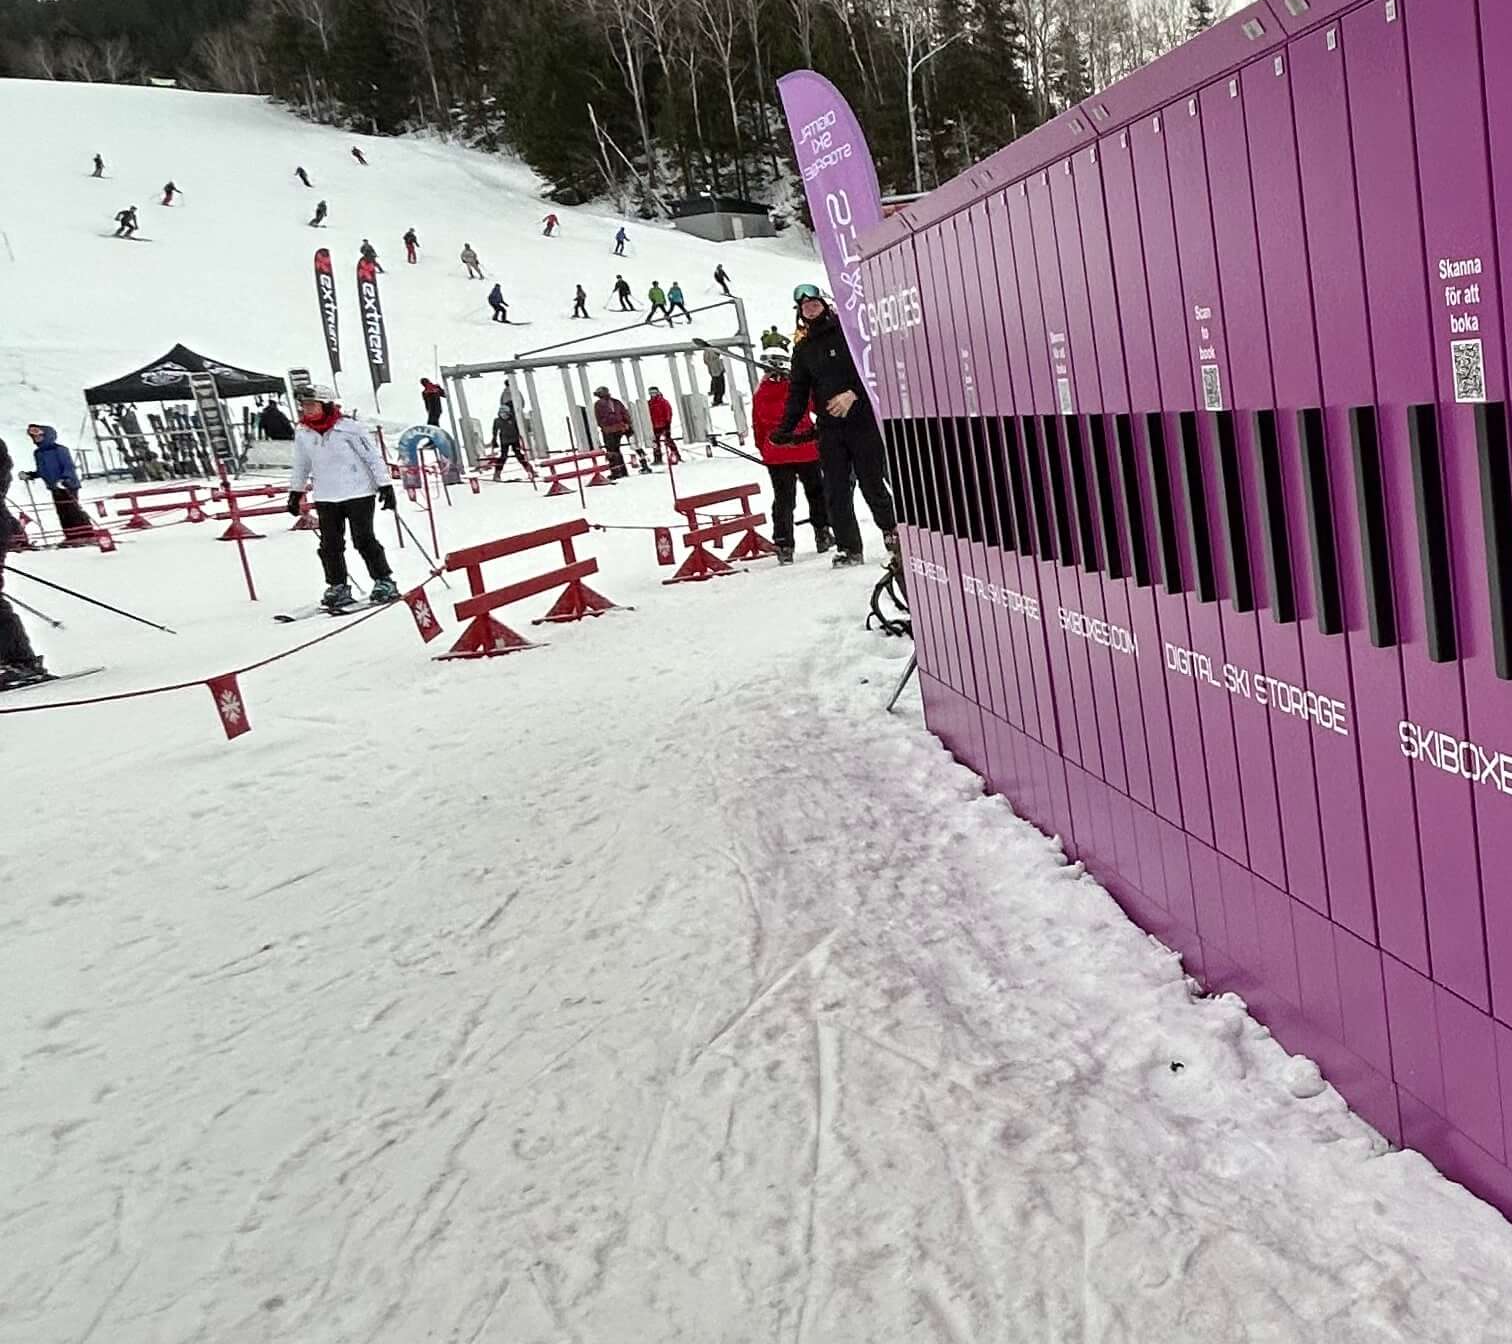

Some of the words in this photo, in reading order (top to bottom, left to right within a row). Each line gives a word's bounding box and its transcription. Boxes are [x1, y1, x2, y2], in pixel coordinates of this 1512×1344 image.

[1439, 258, 1481, 279] Skanna
[1445, 286, 1462, 306] för
[1464, 283, 1480, 304] att
[1450, 312, 1479, 333] boka
[1165, 642, 1221, 687] DIGITAL
[1223, 663, 1251, 699] SKI
[1254, 674, 1349, 736] STORAGE
